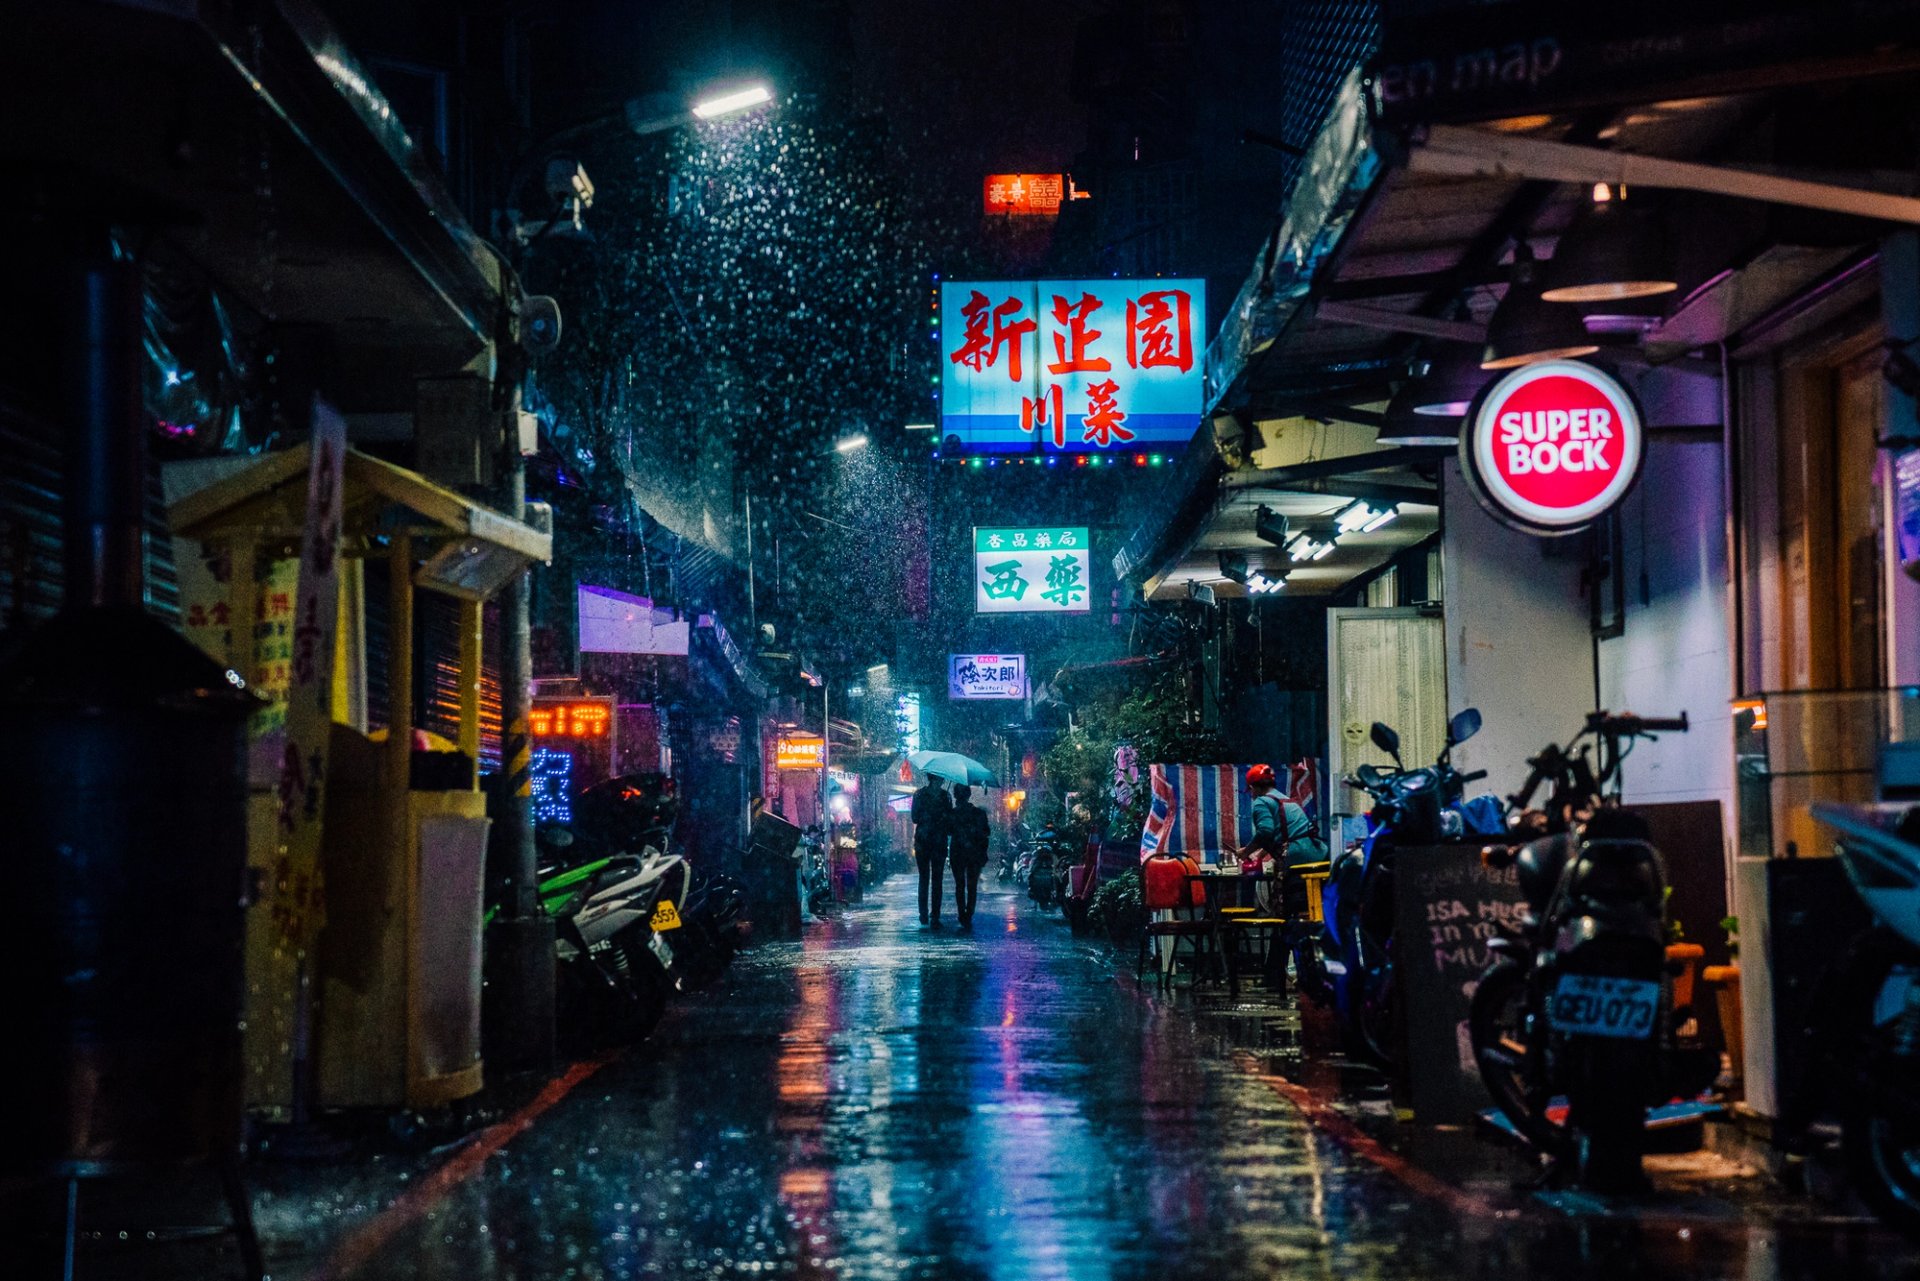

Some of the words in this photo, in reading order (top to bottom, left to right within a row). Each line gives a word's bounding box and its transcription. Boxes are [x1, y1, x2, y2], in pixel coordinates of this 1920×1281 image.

[1451, 36, 1562, 90] map
[1018, 378, 1134, 448] 川菜
[1500, 408, 1613, 444] SUPER
[1507, 439, 1610, 475] BOCK
[981, 553, 1087, 606] 西藥
